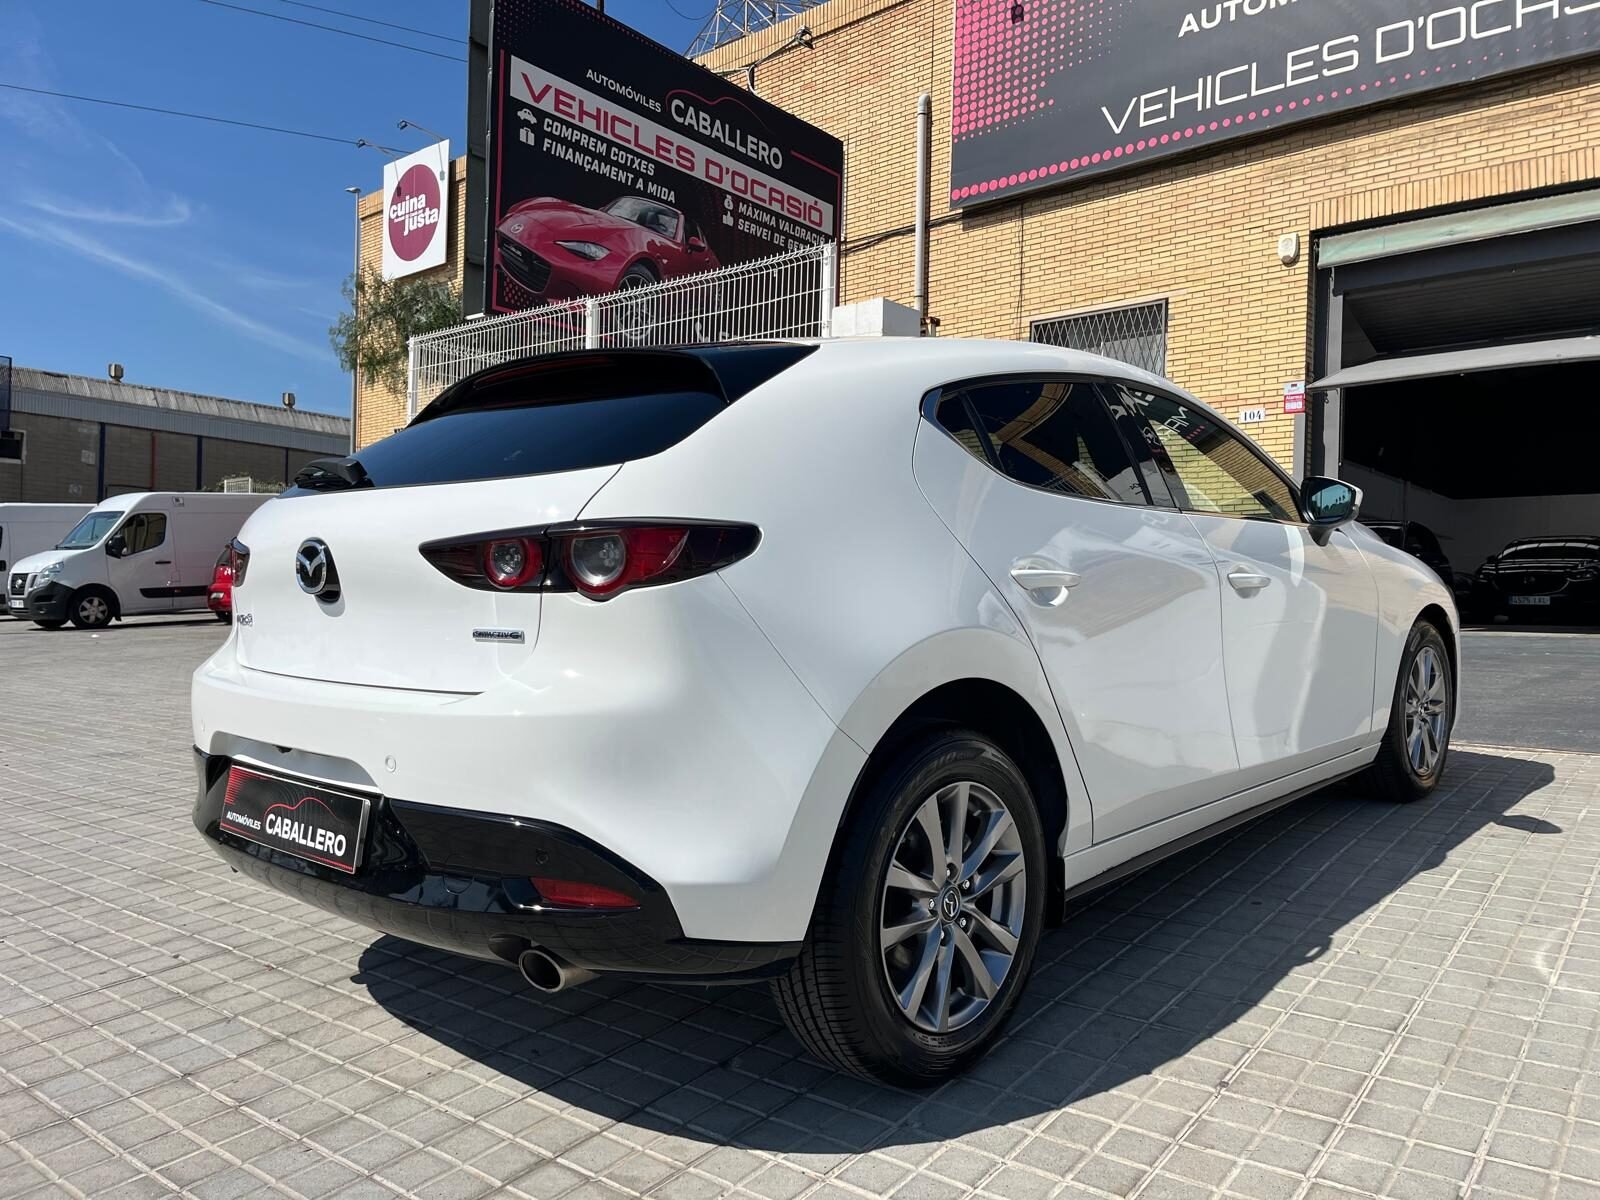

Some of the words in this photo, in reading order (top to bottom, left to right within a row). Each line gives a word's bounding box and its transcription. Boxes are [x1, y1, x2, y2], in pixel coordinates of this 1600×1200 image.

[1101, 34, 1359, 135] VEHICLES
[586, 69, 662, 113] AUTOMÓVILES
[671, 99, 783, 170] CABALLERO
[521, 71, 695, 173] VEHICLES
[705, 158, 823, 228] D'OCASIÓ
[543, 117, 607, 156] COMPREM
[610, 146, 655, 176] COTXES
[543, 138, 634, 186] FINANÇAMENT
[636, 178, 644, 191] A
[647, 181, 676, 204] MIDA
[389, 193, 426, 220] cuina
[403, 207, 439, 236] justa
[737, 218, 771, 241] SERVEI
[773, 234, 786, 247] DE
[1244, 410, 1262, 421] 104
[226, 810, 261, 831] AUTOMÓVILES
[265, 813, 347, 857] CABALLERO
